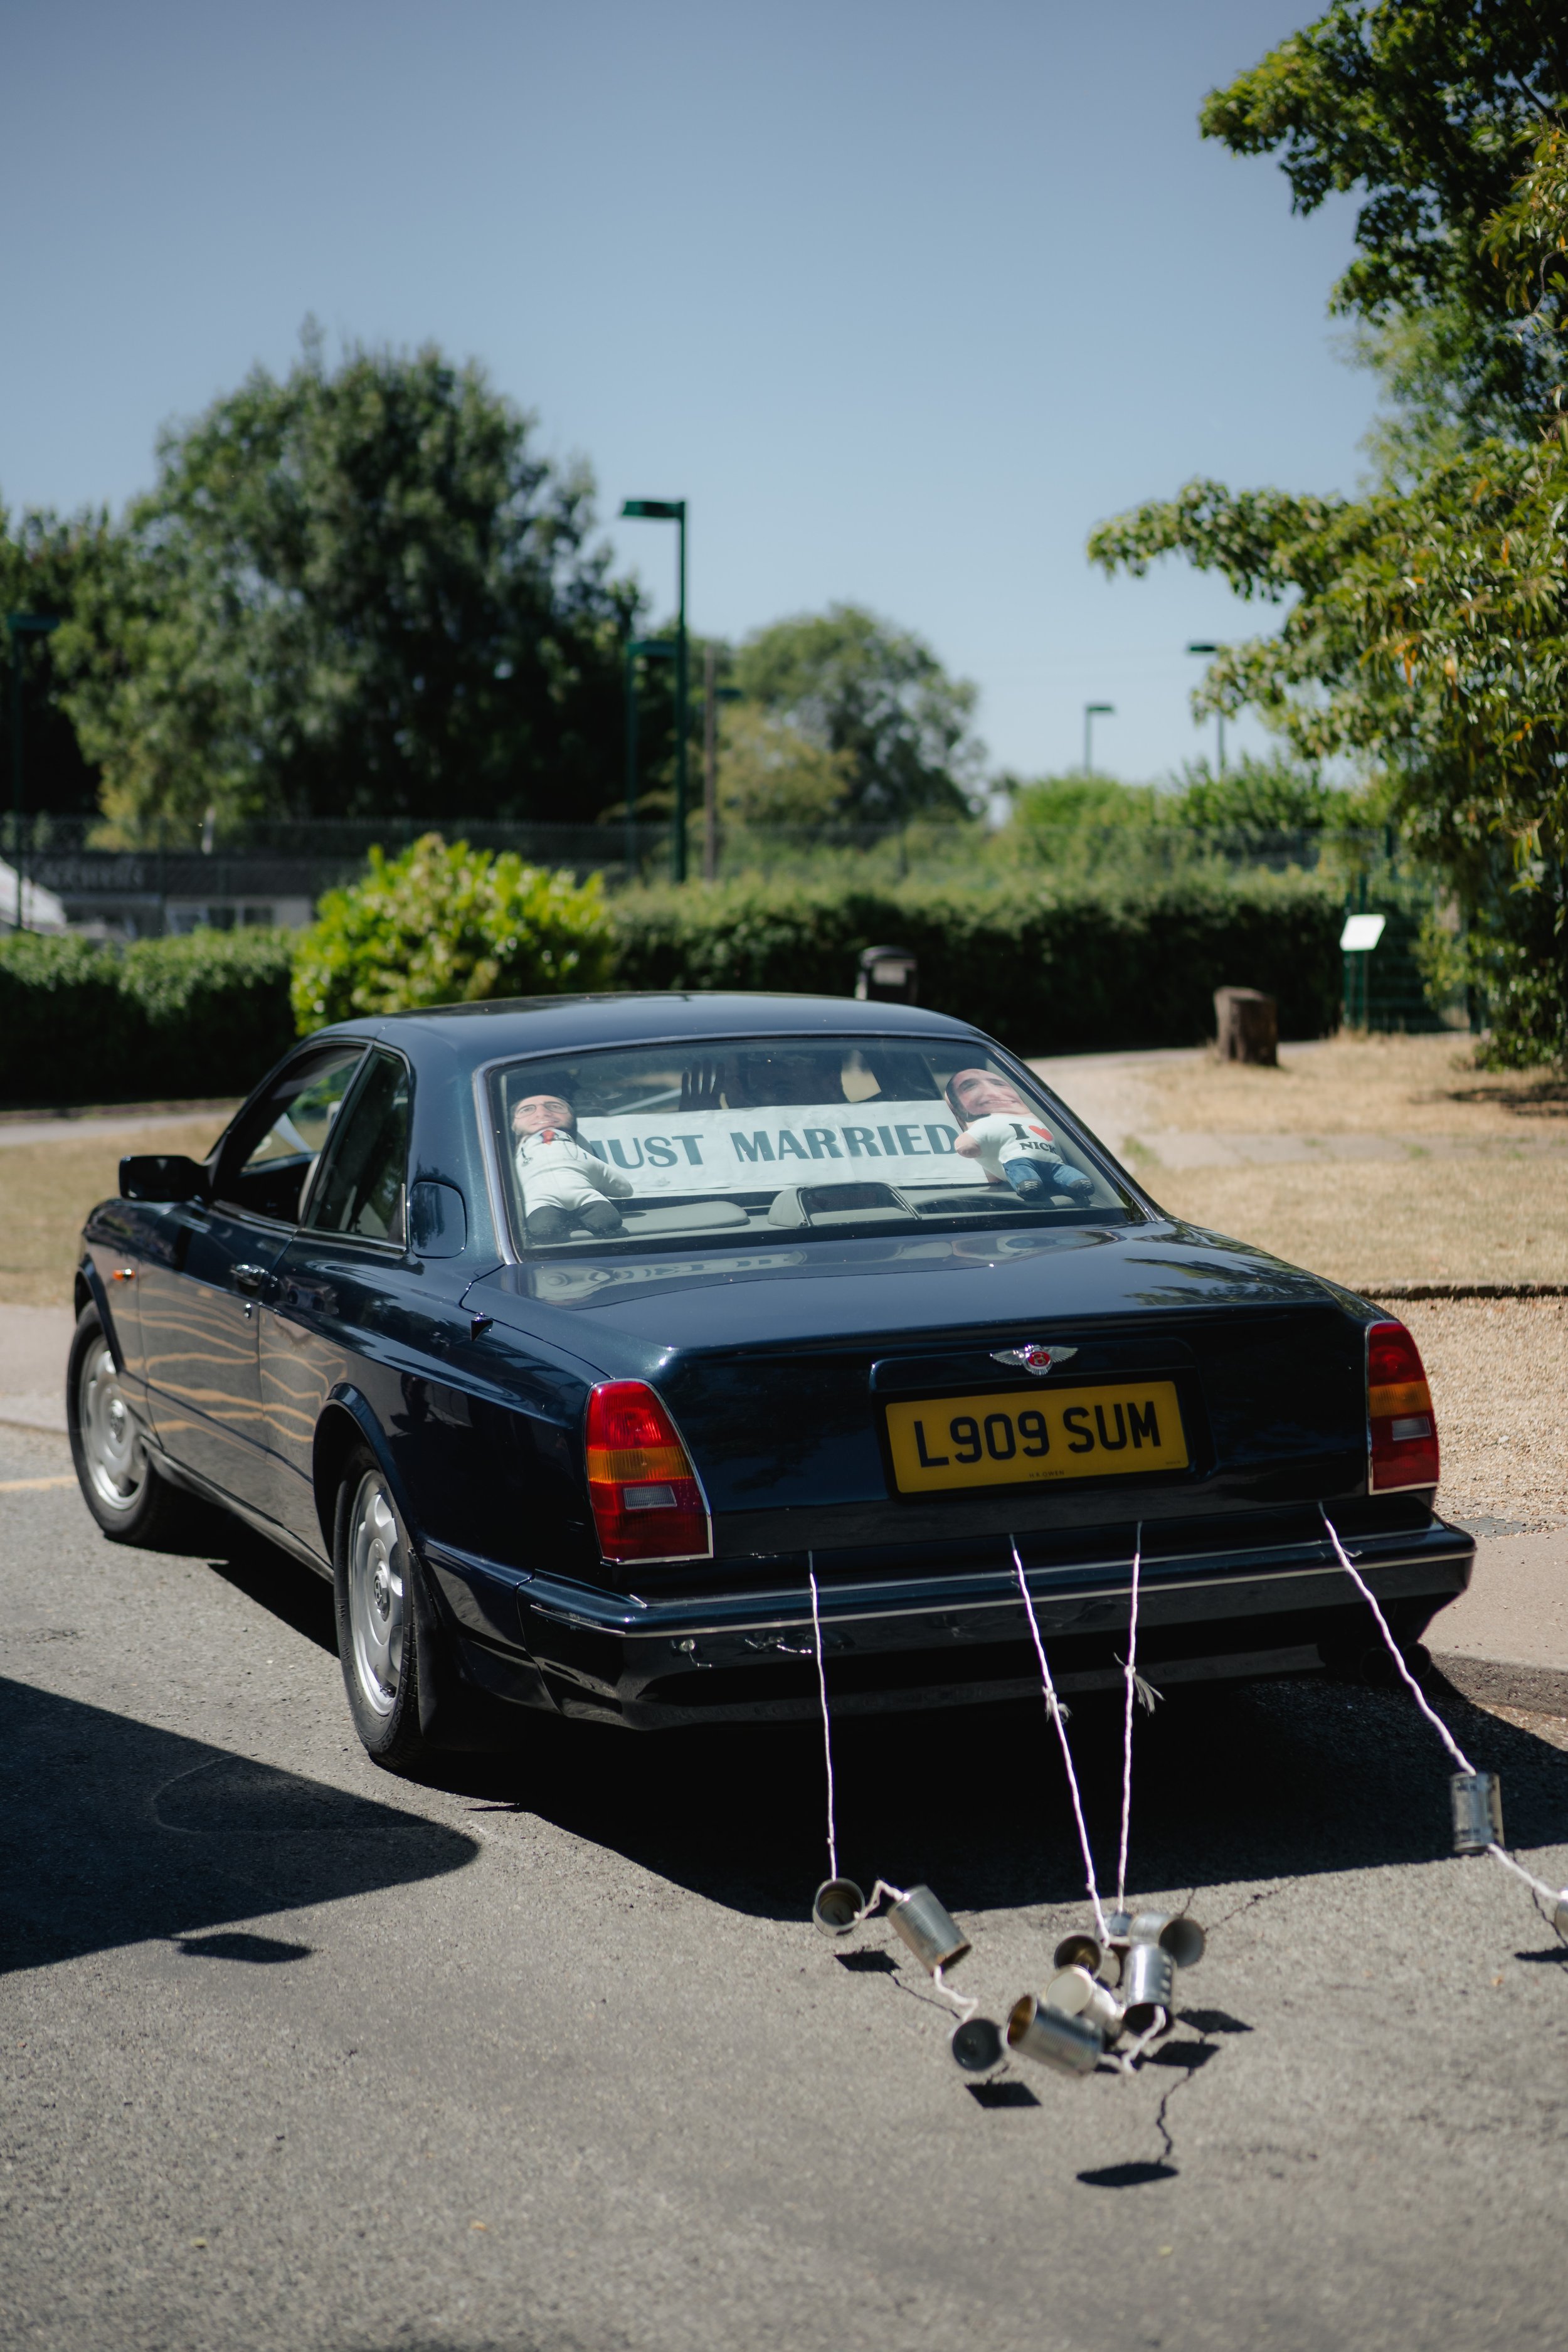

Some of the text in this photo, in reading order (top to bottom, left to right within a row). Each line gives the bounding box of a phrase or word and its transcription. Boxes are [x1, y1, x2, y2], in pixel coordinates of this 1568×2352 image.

[1009, 1123, 1030, 1140] I
[590, 1123, 960, 1169] JUST MARRIED
[1019, 1142, 1057, 1155] NICK
[1033, 1353, 1046, 1365] B
[914, 1401, 1161, 1468] L909 SUM
